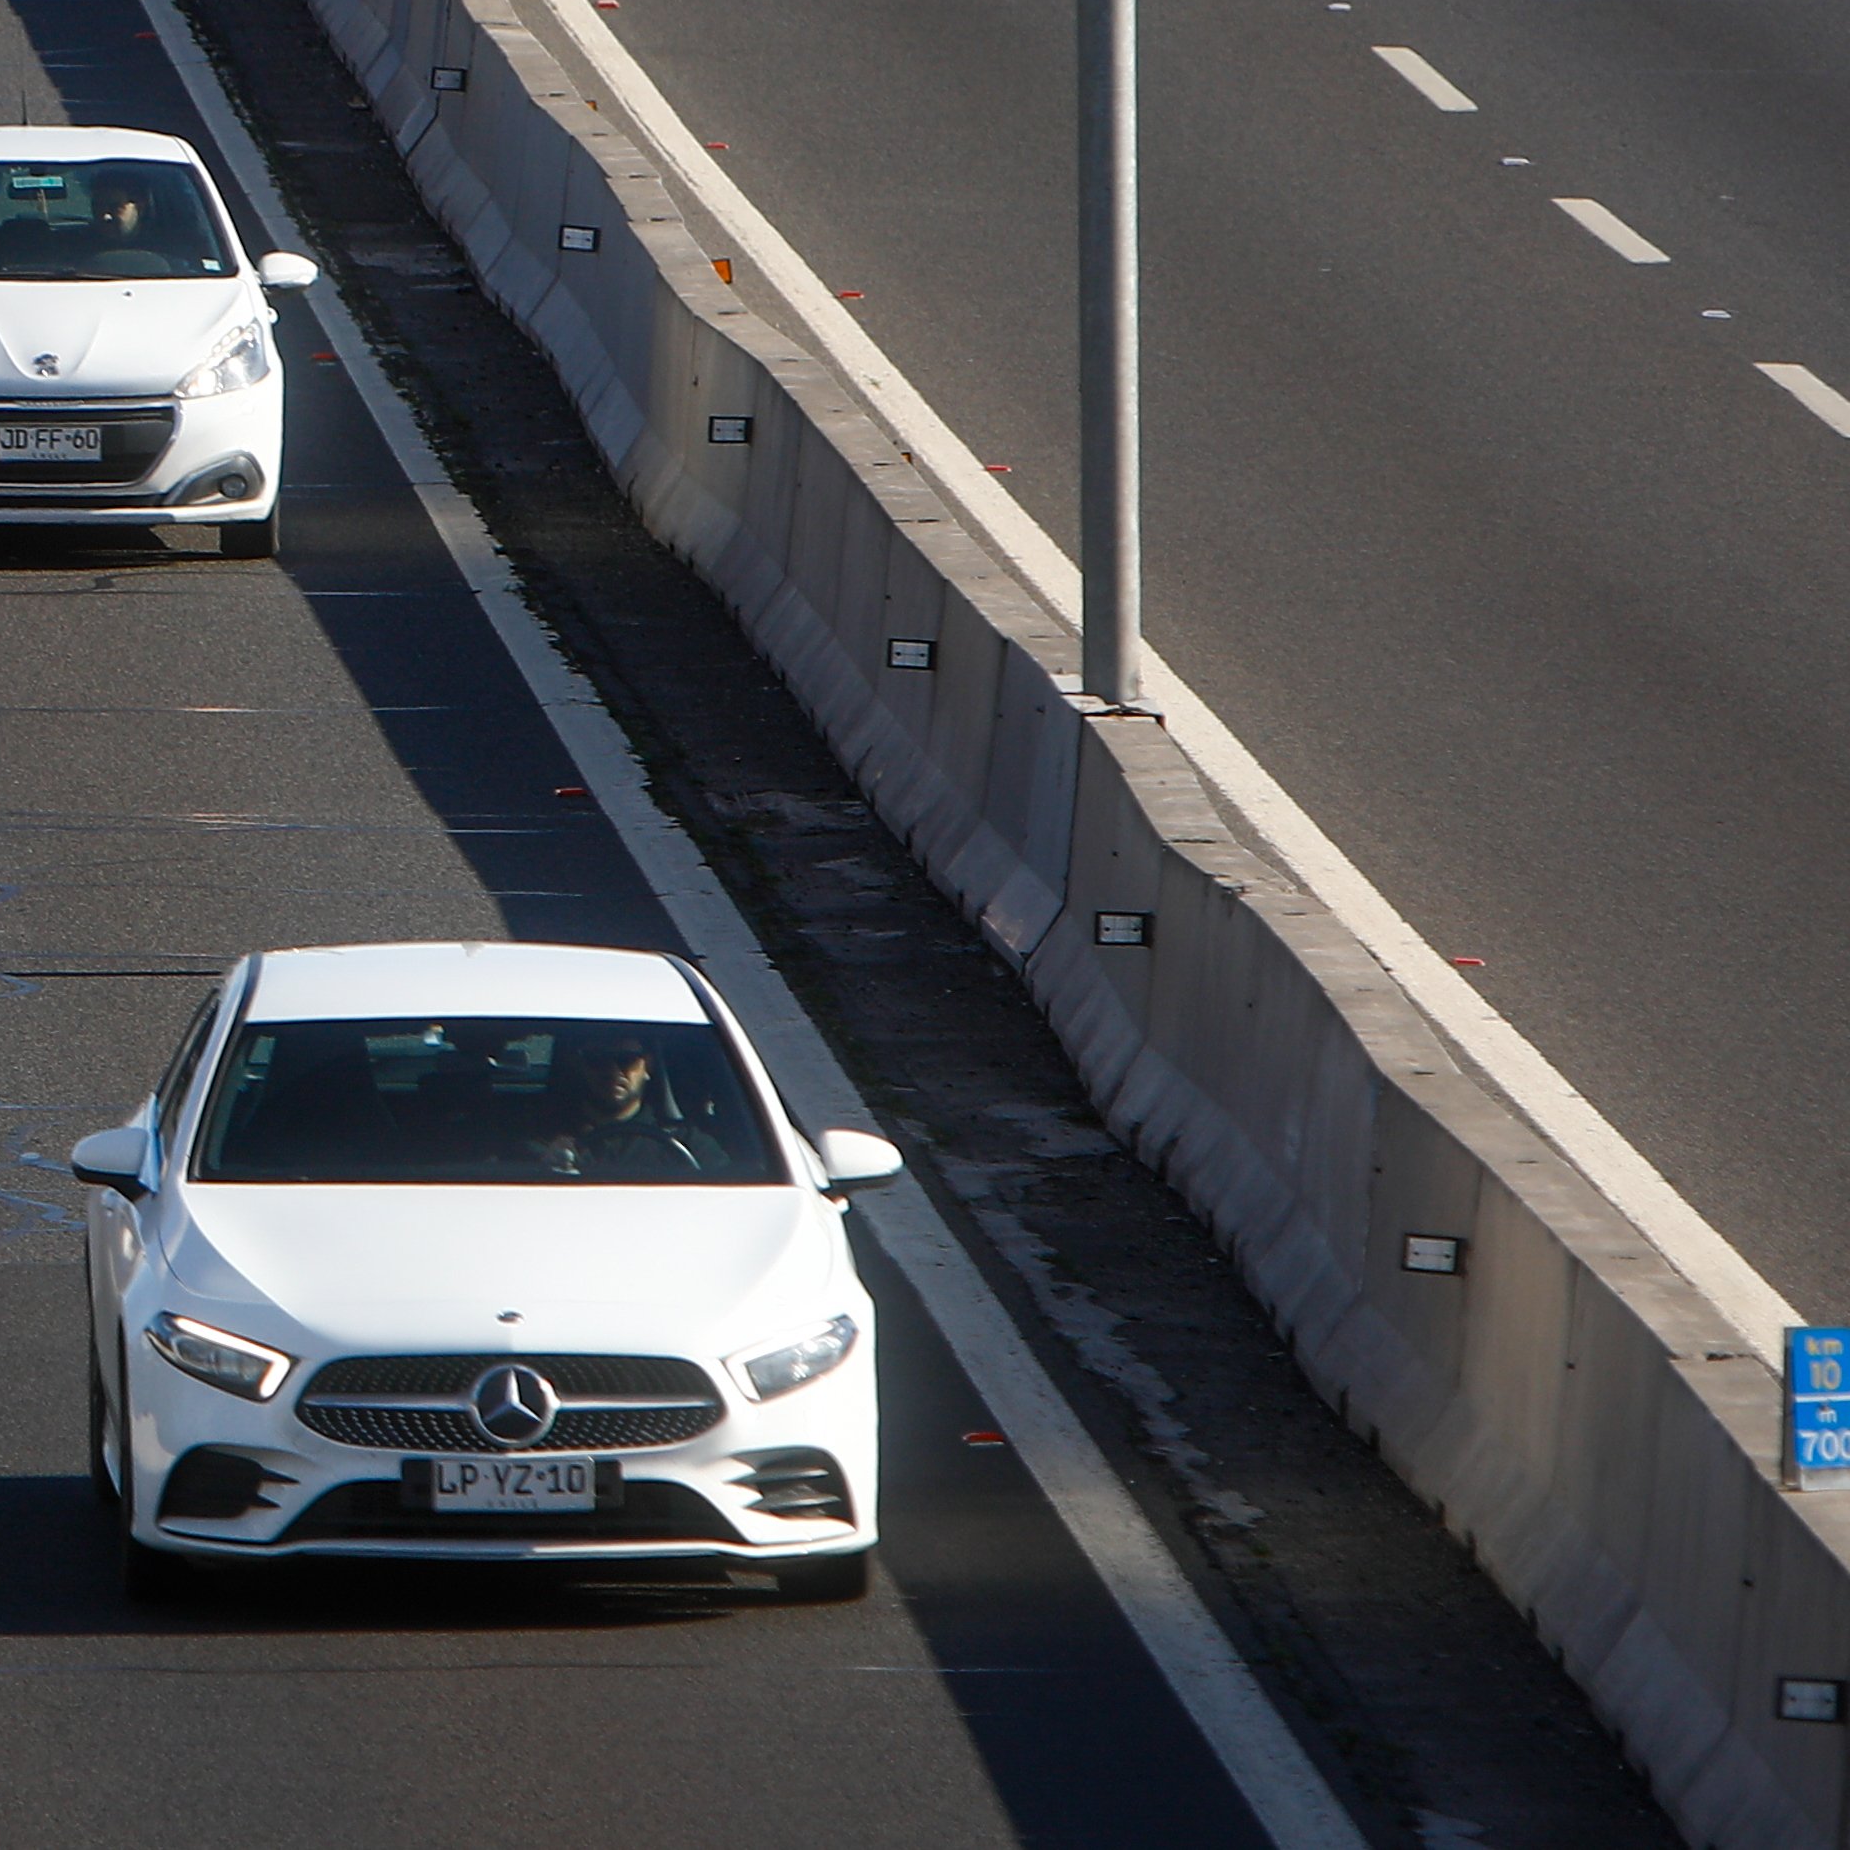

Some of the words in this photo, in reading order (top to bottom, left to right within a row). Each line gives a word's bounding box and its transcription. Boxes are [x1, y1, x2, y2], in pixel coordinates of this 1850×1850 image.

[1804, 1335, 1844, 1356] km
[1809, 1357, 1842, 1389] 10
[1799, 1430, 1850, 1462] 700
